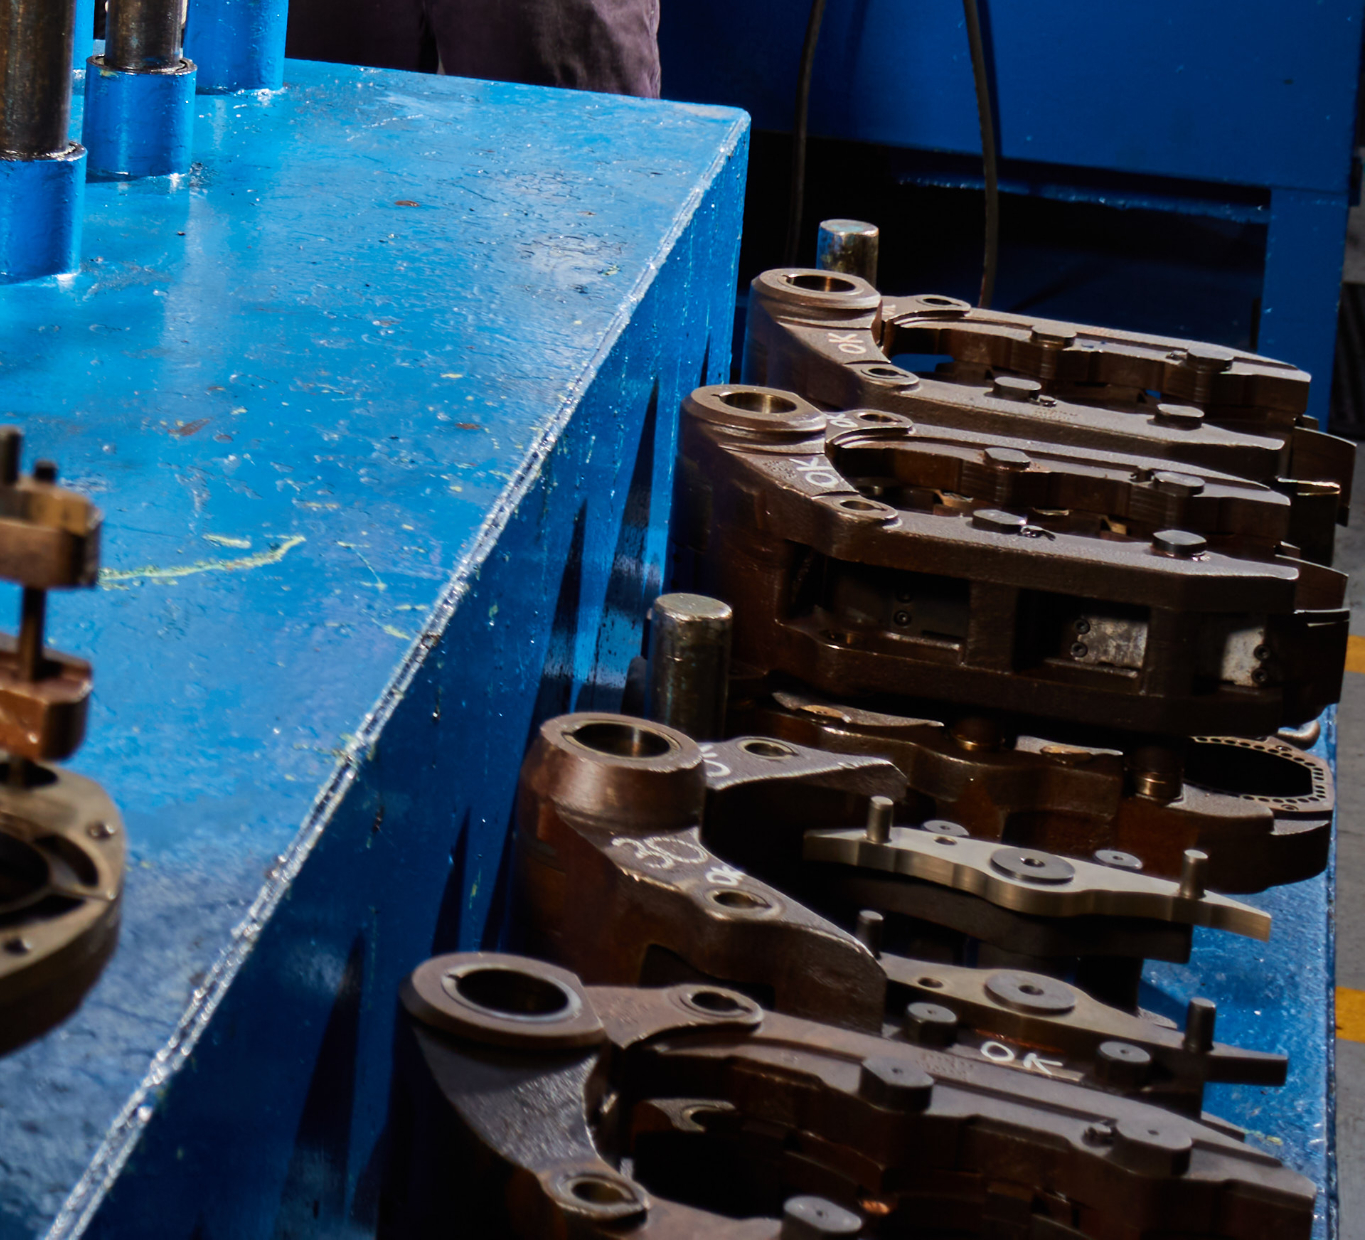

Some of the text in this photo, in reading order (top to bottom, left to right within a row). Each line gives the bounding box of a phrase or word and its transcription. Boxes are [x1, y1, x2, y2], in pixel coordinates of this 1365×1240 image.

[827, 332, 867, 355] OK
[788, 457, 840, 488] OK
[705, 865, 744, 887] OK
[980, 1040, 1064, 1076] OK
